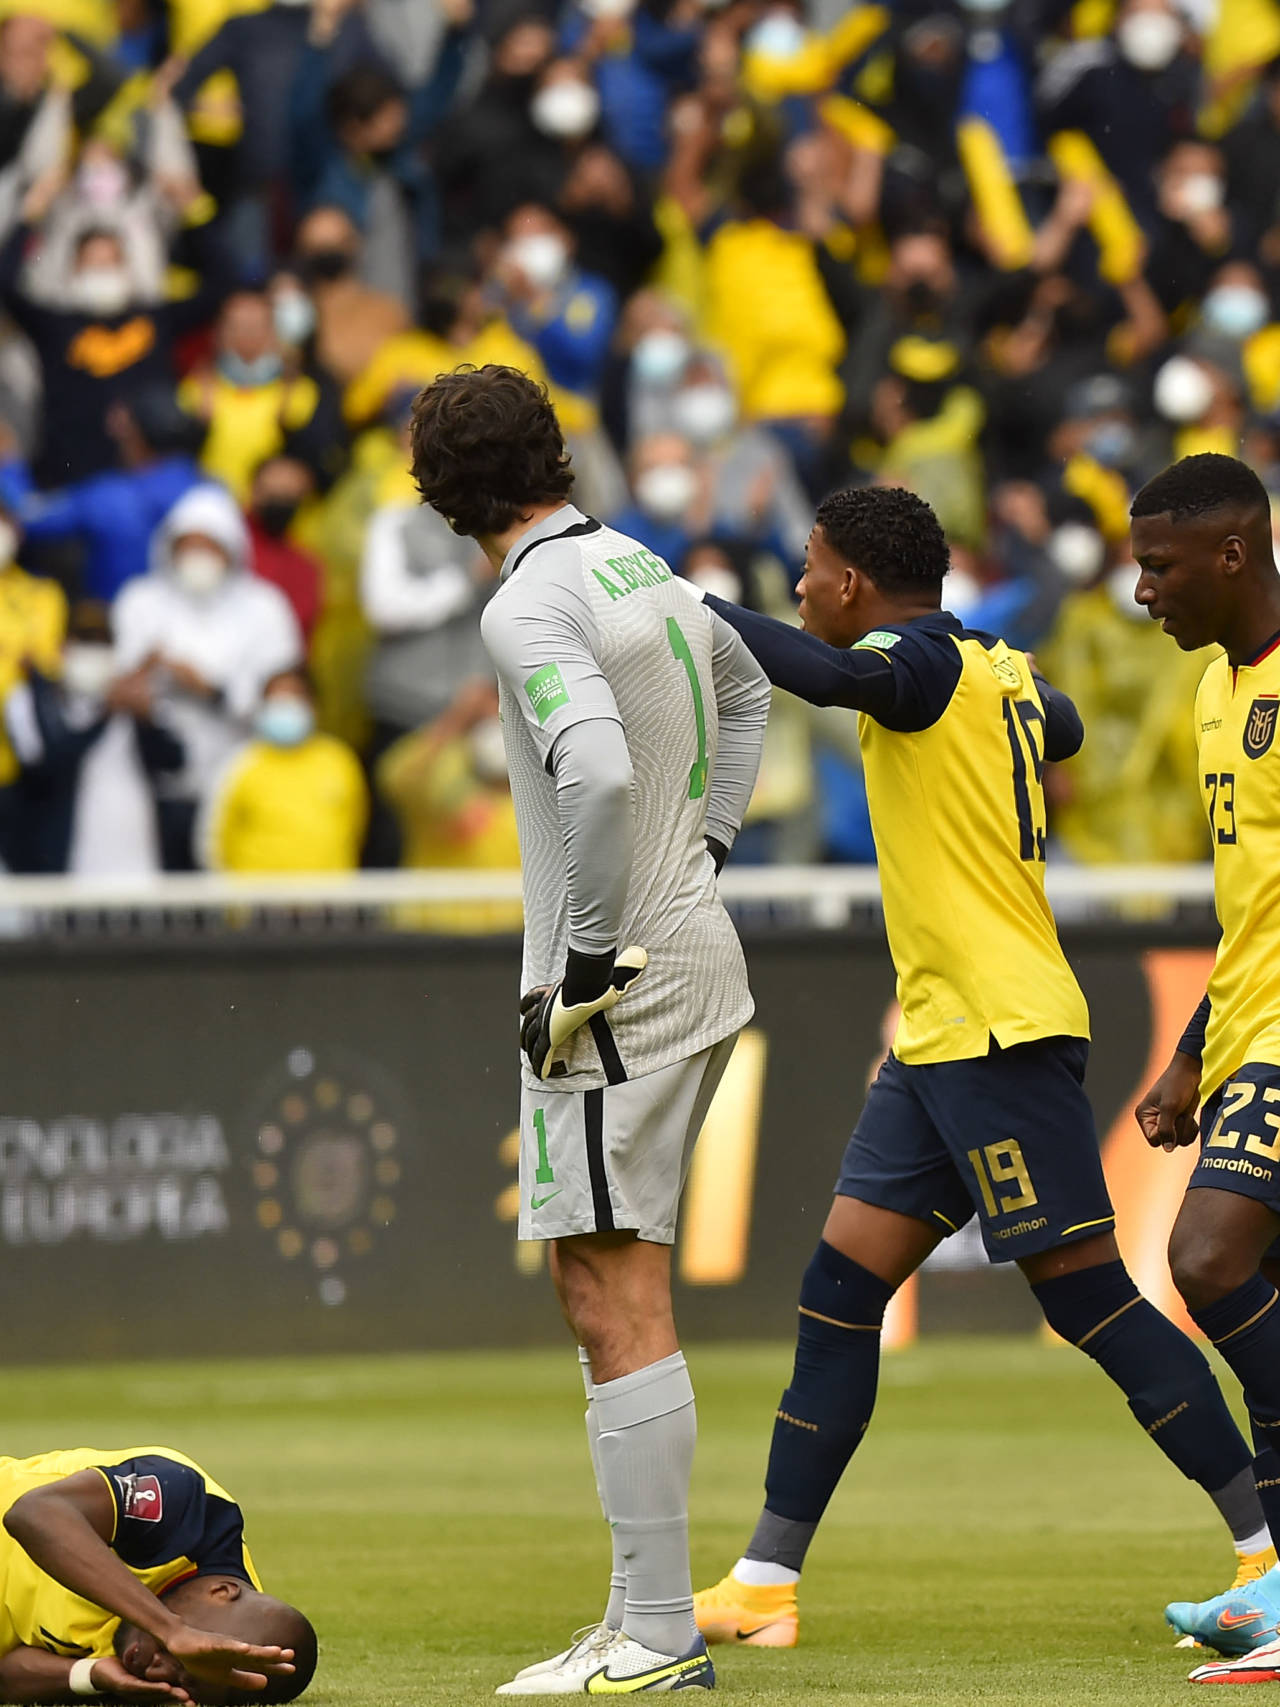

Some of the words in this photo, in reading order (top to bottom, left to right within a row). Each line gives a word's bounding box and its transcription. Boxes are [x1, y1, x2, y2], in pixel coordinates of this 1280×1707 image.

[666, 616, 709, 800] 1
[533, 1108, 555, 1184] 1
[967, 1137, 1038, 1218] 19
[1201, 1157, 1272, 1182] marathon
